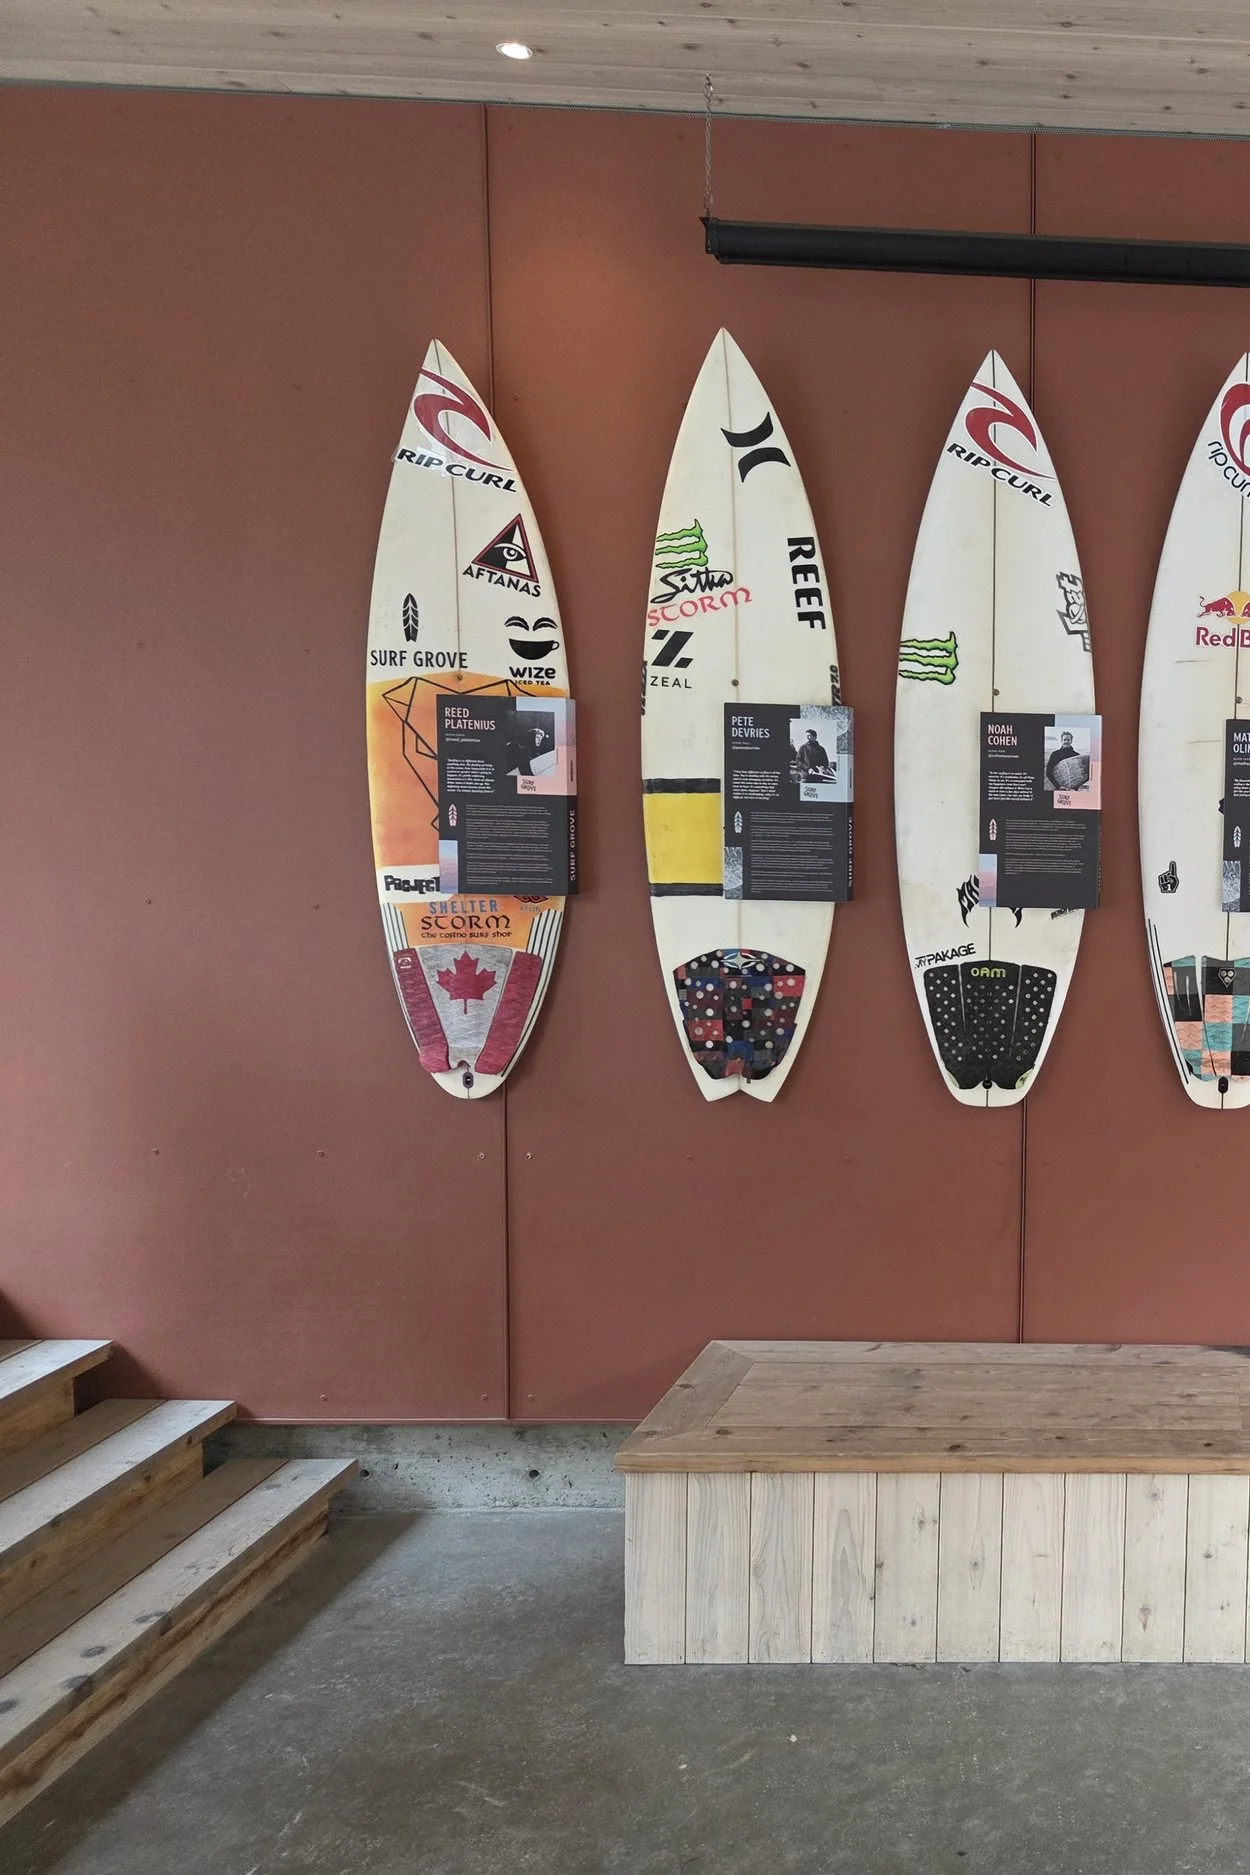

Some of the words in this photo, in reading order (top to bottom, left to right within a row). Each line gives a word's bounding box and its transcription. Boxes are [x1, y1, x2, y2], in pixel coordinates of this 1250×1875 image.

[1207, 440, 1228, 467] rip
[396, 448, 443, 469] RIP
[445, 464, 517, 493] CURL
[947, 442, 991, 468] RIP
[990, 467, 1053, 507] CURL
[462, 563, 541, 598] AFTANAS
[787, 536, 827, 630] REEF
[647, 587, 752, 627] STORM
[1196, 626, 1237, 647] Red
[370, 649, 407, 667] SURF
[413, 651, 469, 669] GROVE
[650, 675, 693, 689] ZEAL
[445, 707, 470, 718] REED
[445, 718, 496, 731] PLATENIUS
[732, 716, 754, 727] PETE
[988, 724, 1013, 735] NOAH
[731, 727, 770, 739] DEVRIES
[988, 735, 1018, 746] COHEN
[429, 900, 499, 915] SHELTER
[420, 915, 511, 931] STORM
